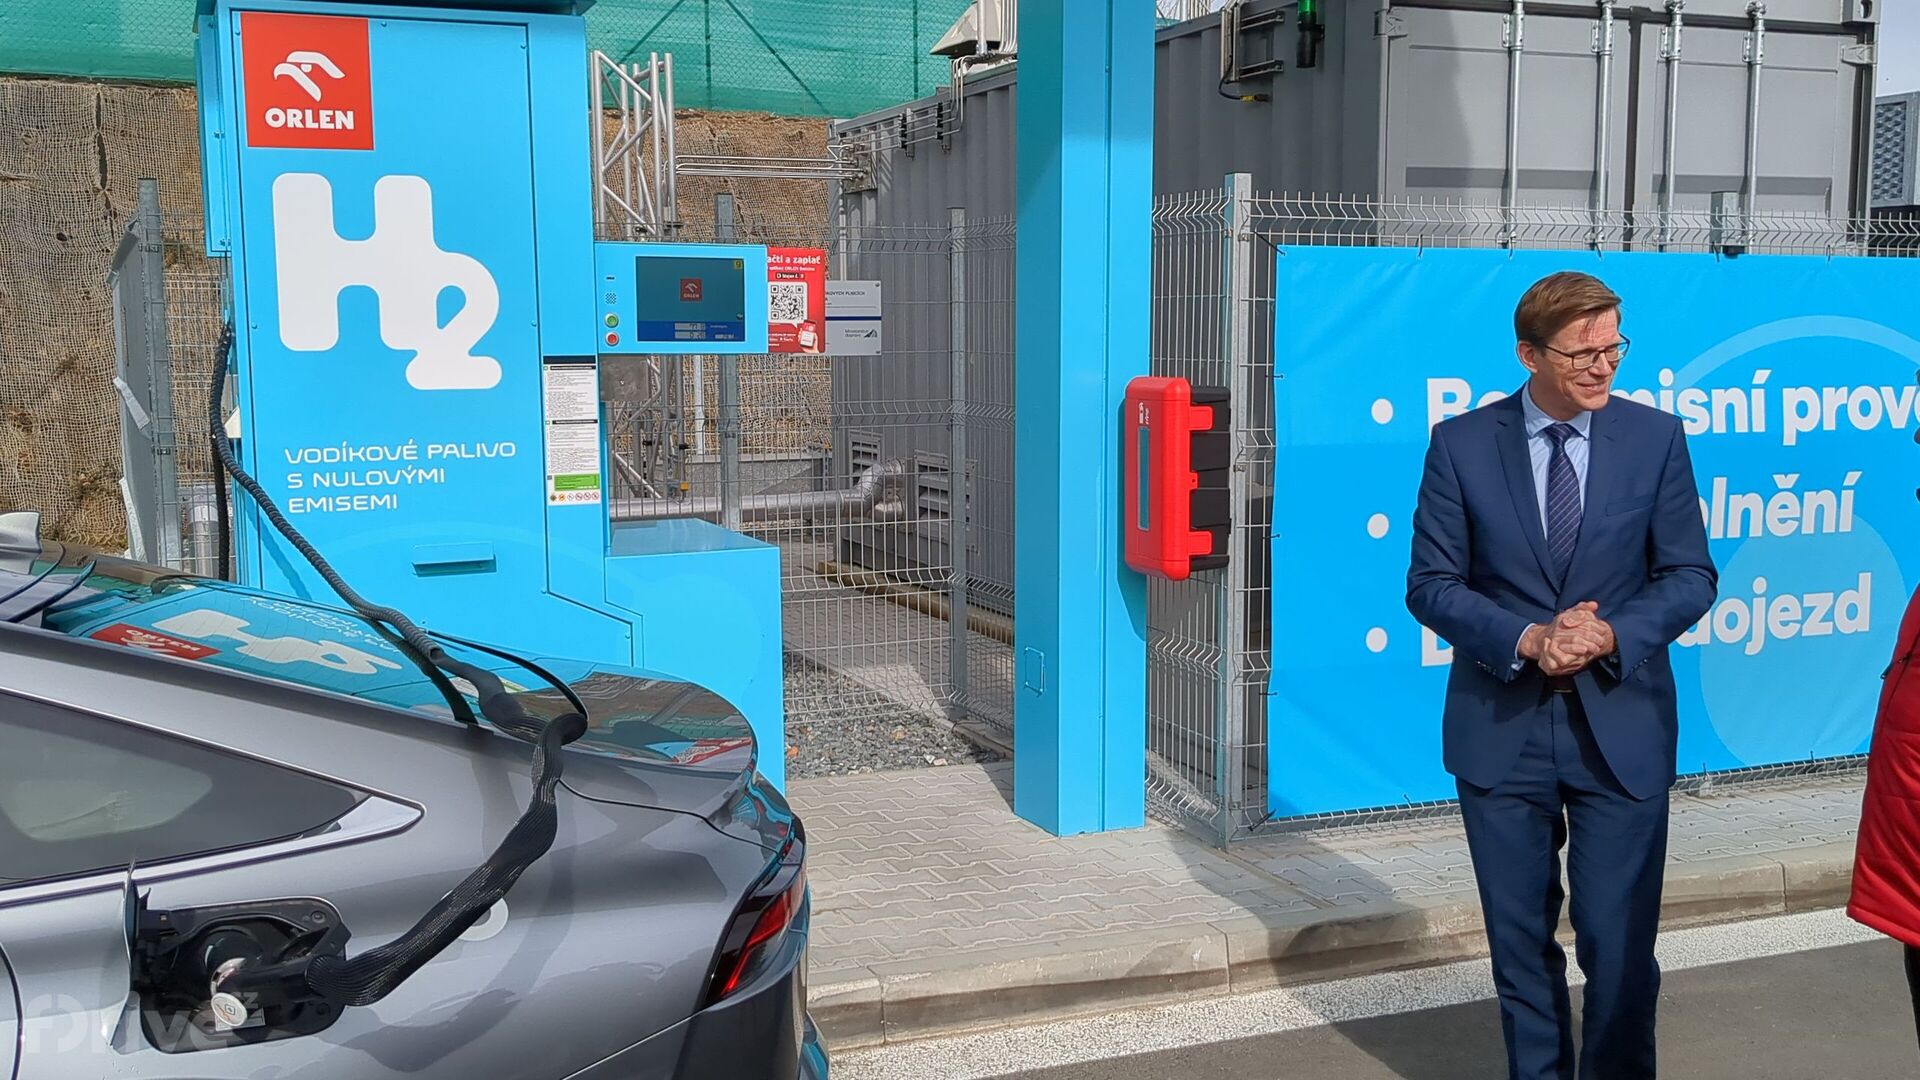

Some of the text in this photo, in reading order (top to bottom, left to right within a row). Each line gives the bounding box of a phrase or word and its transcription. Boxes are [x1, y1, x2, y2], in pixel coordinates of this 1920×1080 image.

[265, 108, 354, 130] ORLEN
[785, 256, 791, 264] a
[1782, 385, 1920, 446] prov
[285, 439, 516, 464] VODÍKOVÉ PALIVO
[287, 465, 445, 489] S NULOVÝMI
[288, 494, 398, 513] EMISEMI
